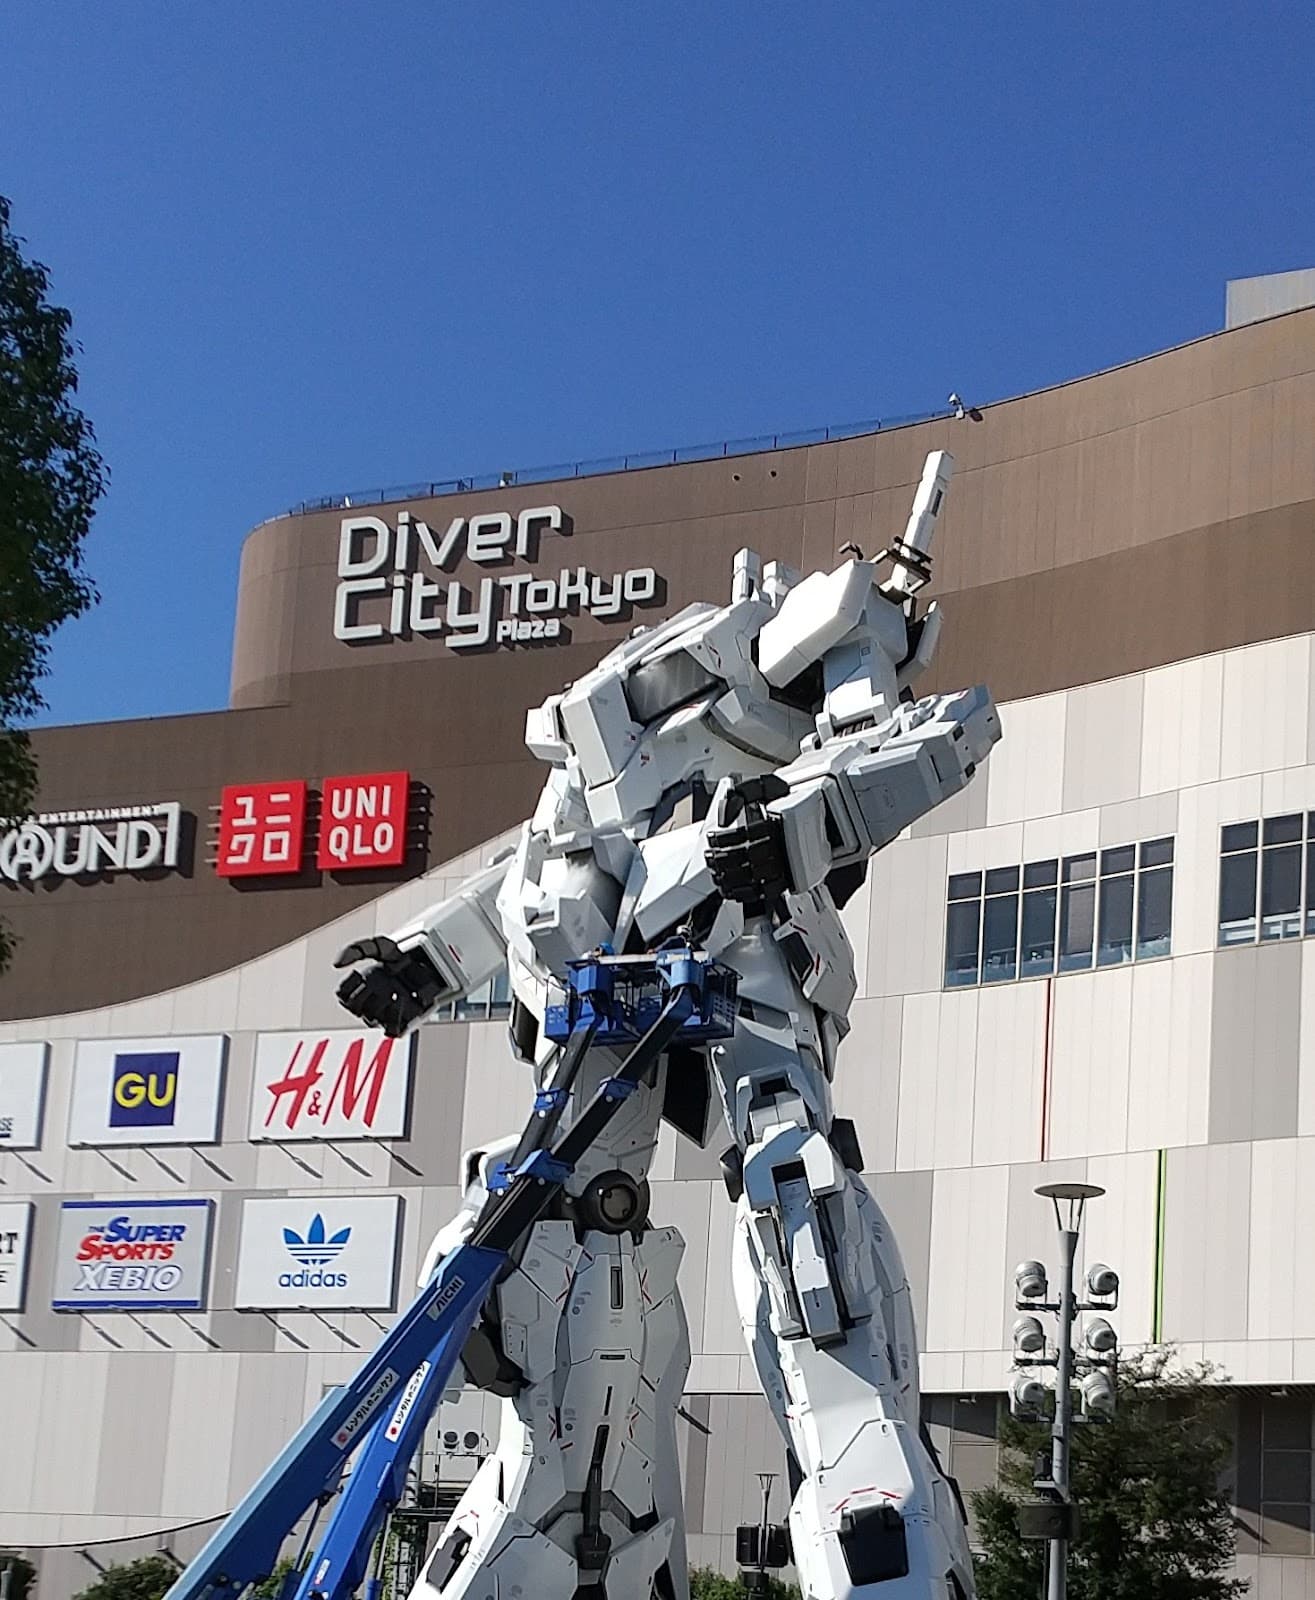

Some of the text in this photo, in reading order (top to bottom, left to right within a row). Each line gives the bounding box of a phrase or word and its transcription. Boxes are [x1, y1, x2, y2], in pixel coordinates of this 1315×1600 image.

[337, 504, 562, 578] Diver
[333, 566, 655, 648] City Tokyo
[497, 618, 560, 643] Plaza
[38, 805, 161, 825] ENTERTAINMENT
[231, 793, 291, 827] ユニ
[332, 785, 391, 820] UNI
[226, 831, 290, 864] クロ
[329, 822, 394, 862] QLO
[114, 1072, 177, 1108] GU
[267, 1038, 394, 1129] H&M
[103, 1216, 186, 1242] SUPER
[76, 1234, 175, 1260] SPORTS
[73, 1261, 183, 1291] XEBIO
[278, 1268, 348, 1288] adidas
[436, 1277, 463, 1313] AICHI
